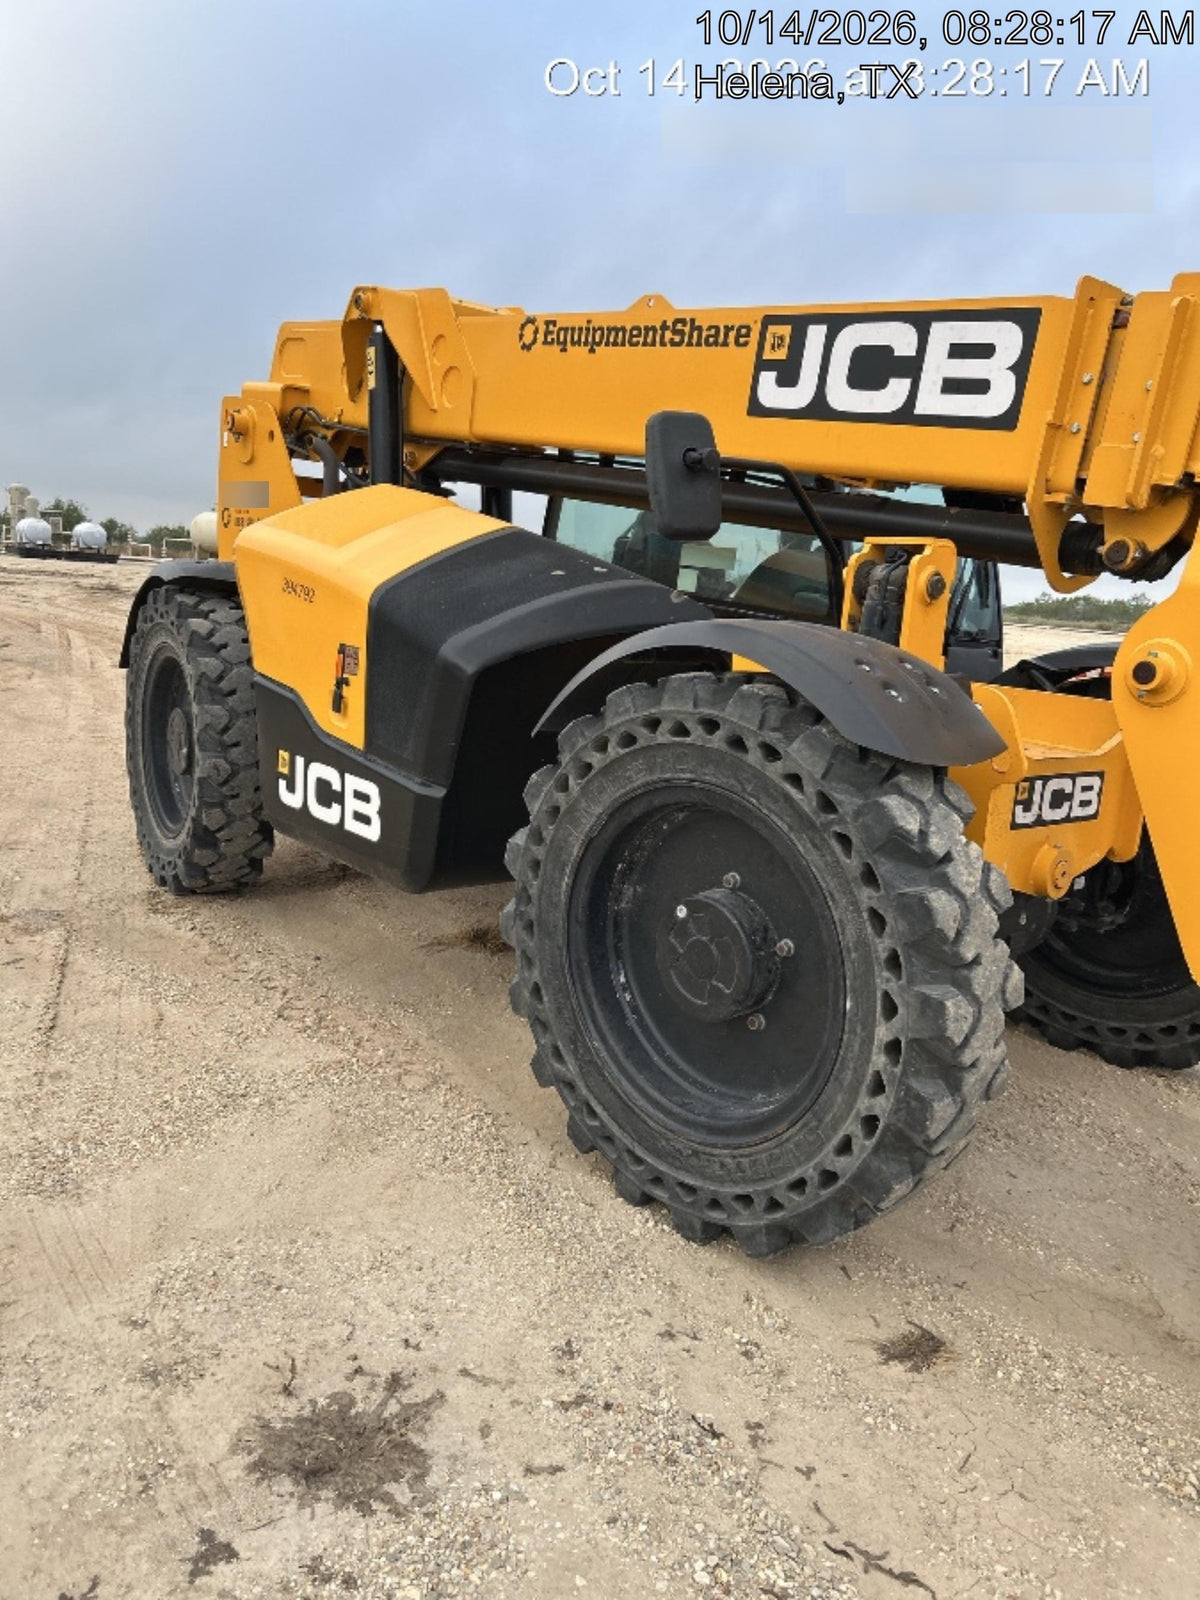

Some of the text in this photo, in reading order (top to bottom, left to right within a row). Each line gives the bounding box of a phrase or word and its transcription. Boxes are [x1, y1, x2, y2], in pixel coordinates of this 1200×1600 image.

[542, 317, 751, 354] EquipmentShare
[756, 320, 1024, 418] JCB
[278, 754, 382, 843] JCB
[1014, 775, 1102, 825] JCB
